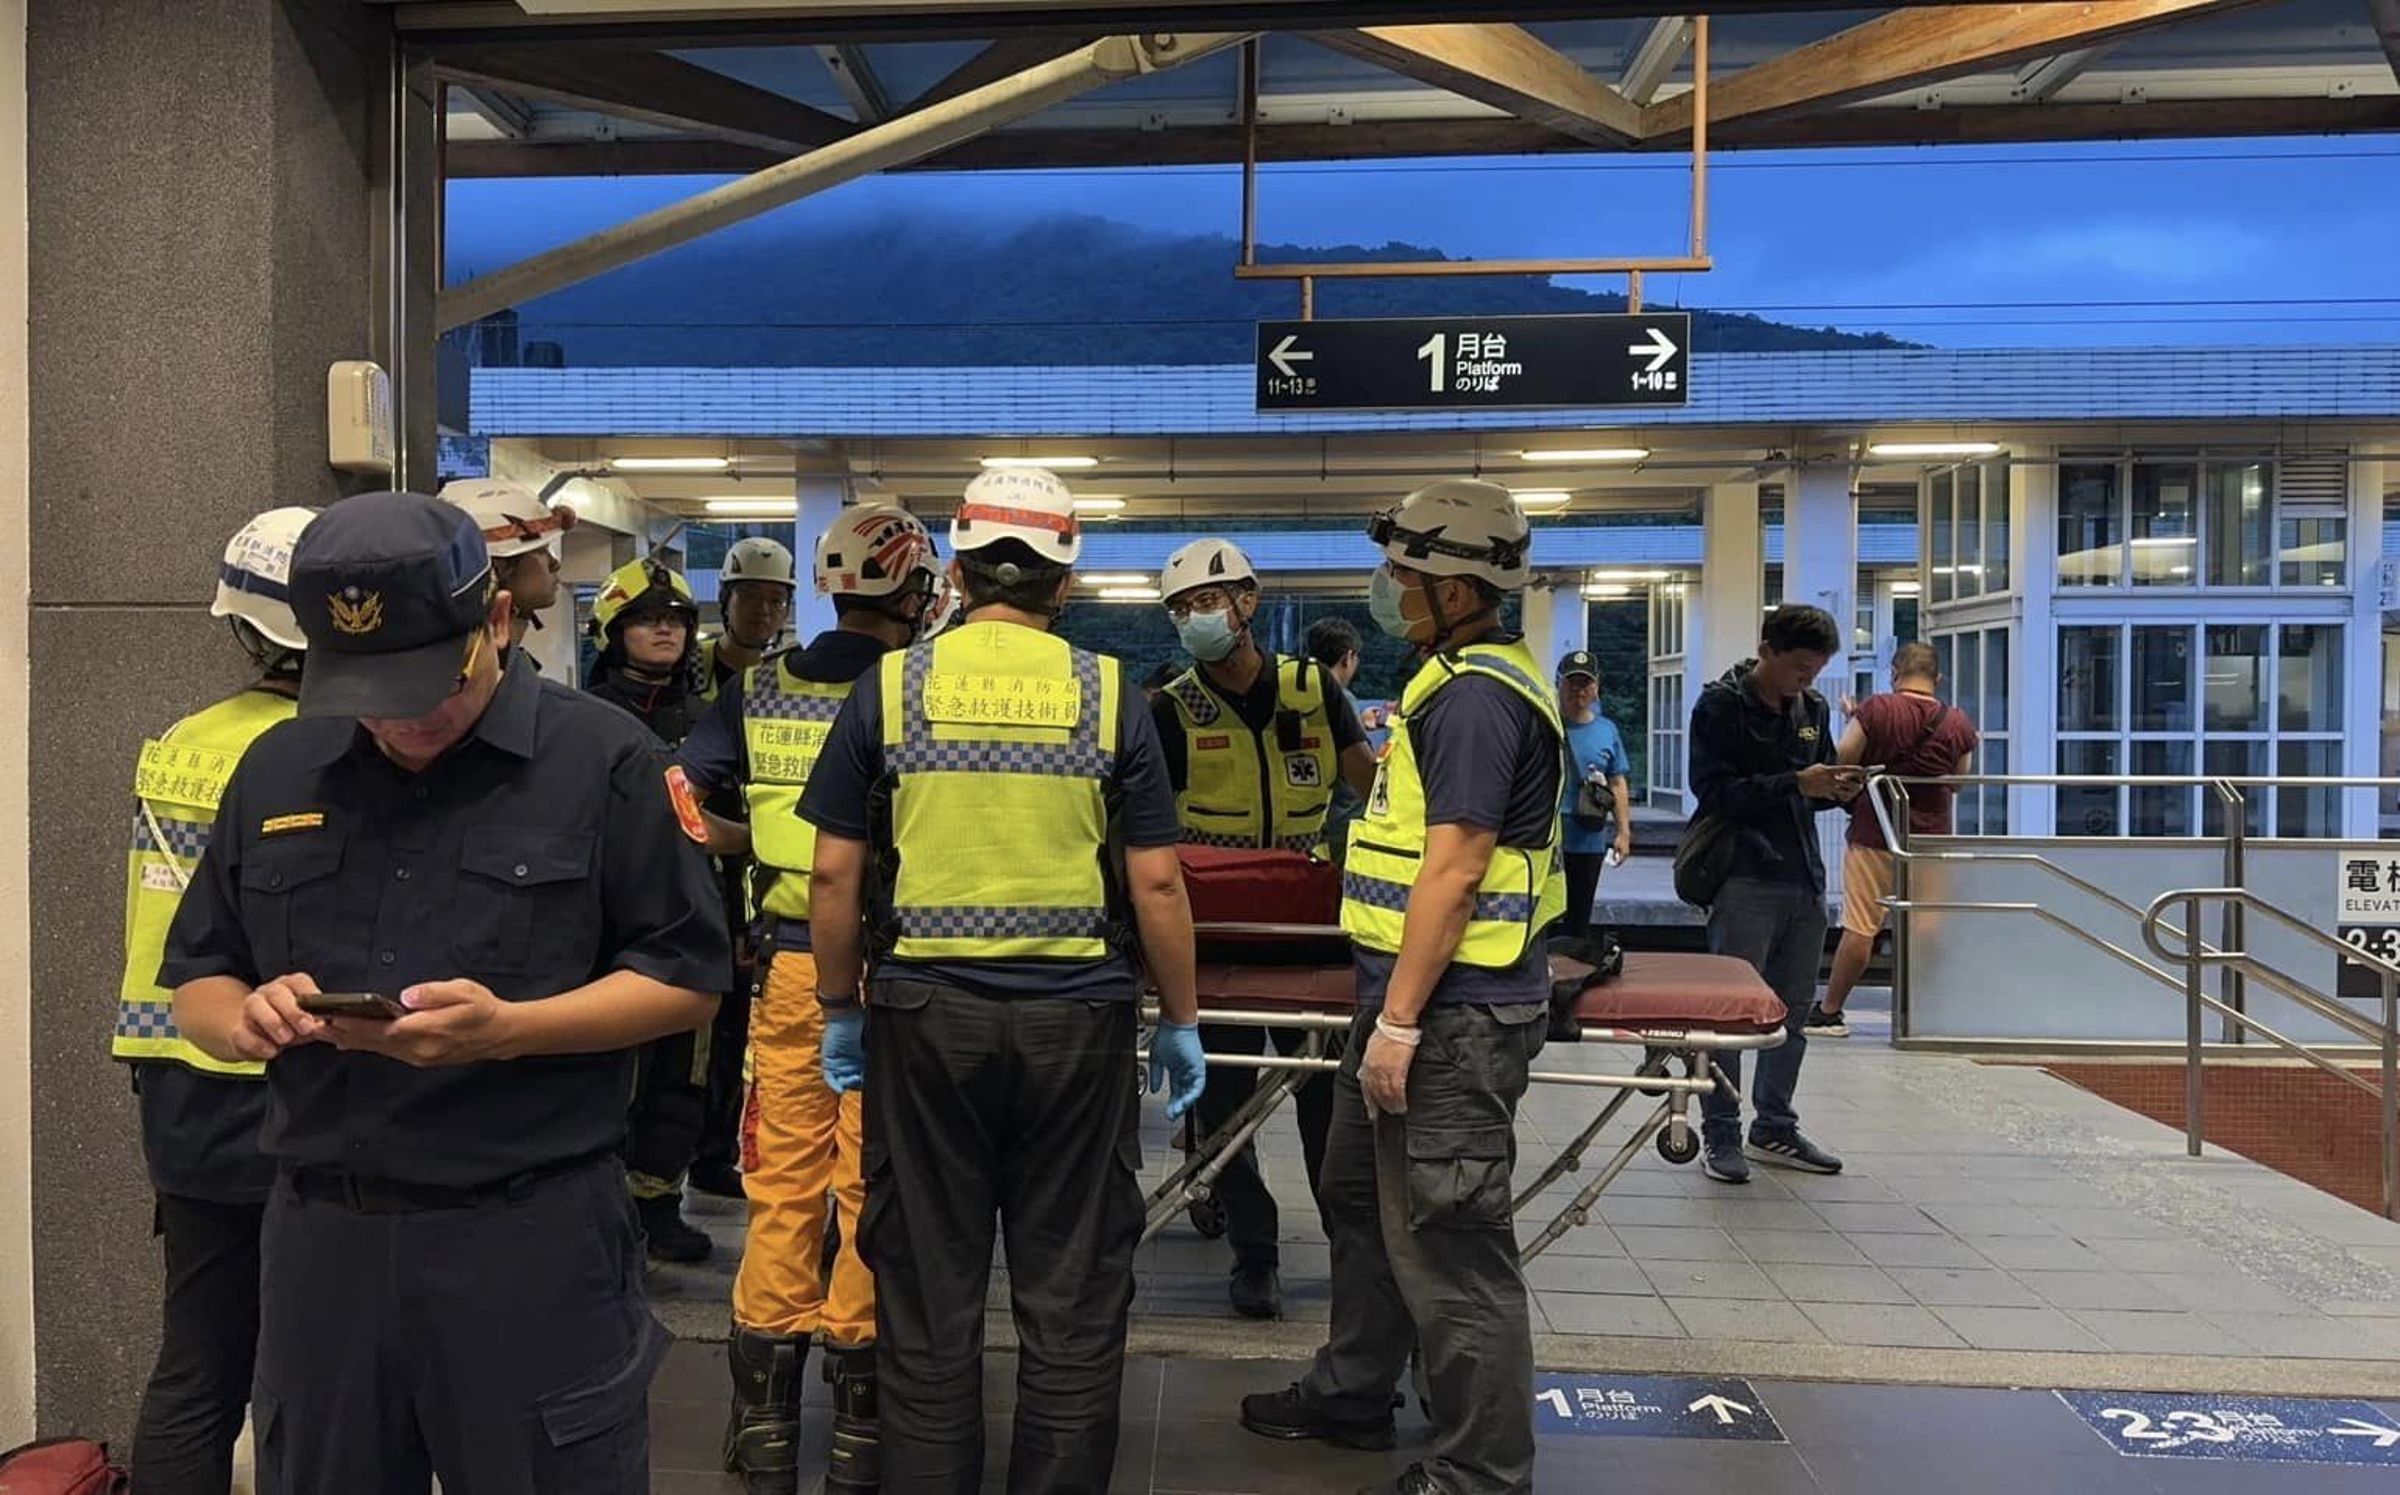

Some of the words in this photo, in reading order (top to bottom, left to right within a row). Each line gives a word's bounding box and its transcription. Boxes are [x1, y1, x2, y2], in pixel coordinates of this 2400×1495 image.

[1456, 333, 1507, 359] 月台
[1417, 333, 1445, 392] 1
[1456, 360, 1522, 375] Platform
[1456, 376, 1500, 392] のりば
[1535, 1389, 1572, 1417] 1
[1576, 1389, 1635, 1403] 月台
[1582, 1402, 1662, 1413] Platform
